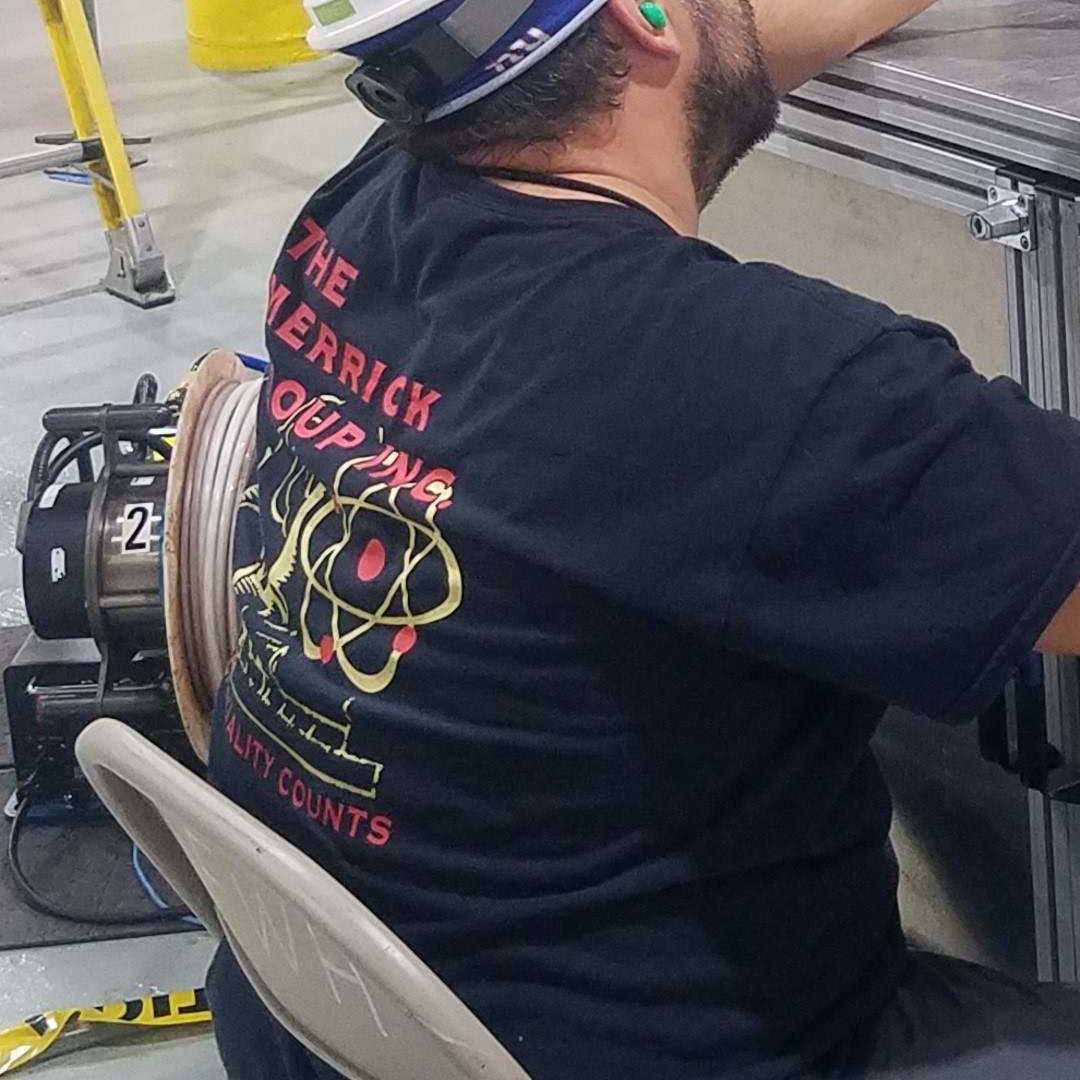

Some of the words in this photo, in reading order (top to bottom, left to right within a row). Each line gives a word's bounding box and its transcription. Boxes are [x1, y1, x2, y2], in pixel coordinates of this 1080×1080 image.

[287, 217, 359, 308] THE
[266, 273, 442, 432] MERRICK
[270, 380, 366, 450] OUP
[124, 506, 149, 551] 2
[225, 715, 275, 779] ALITY
[278, 766, 393, 846] COUNTS
